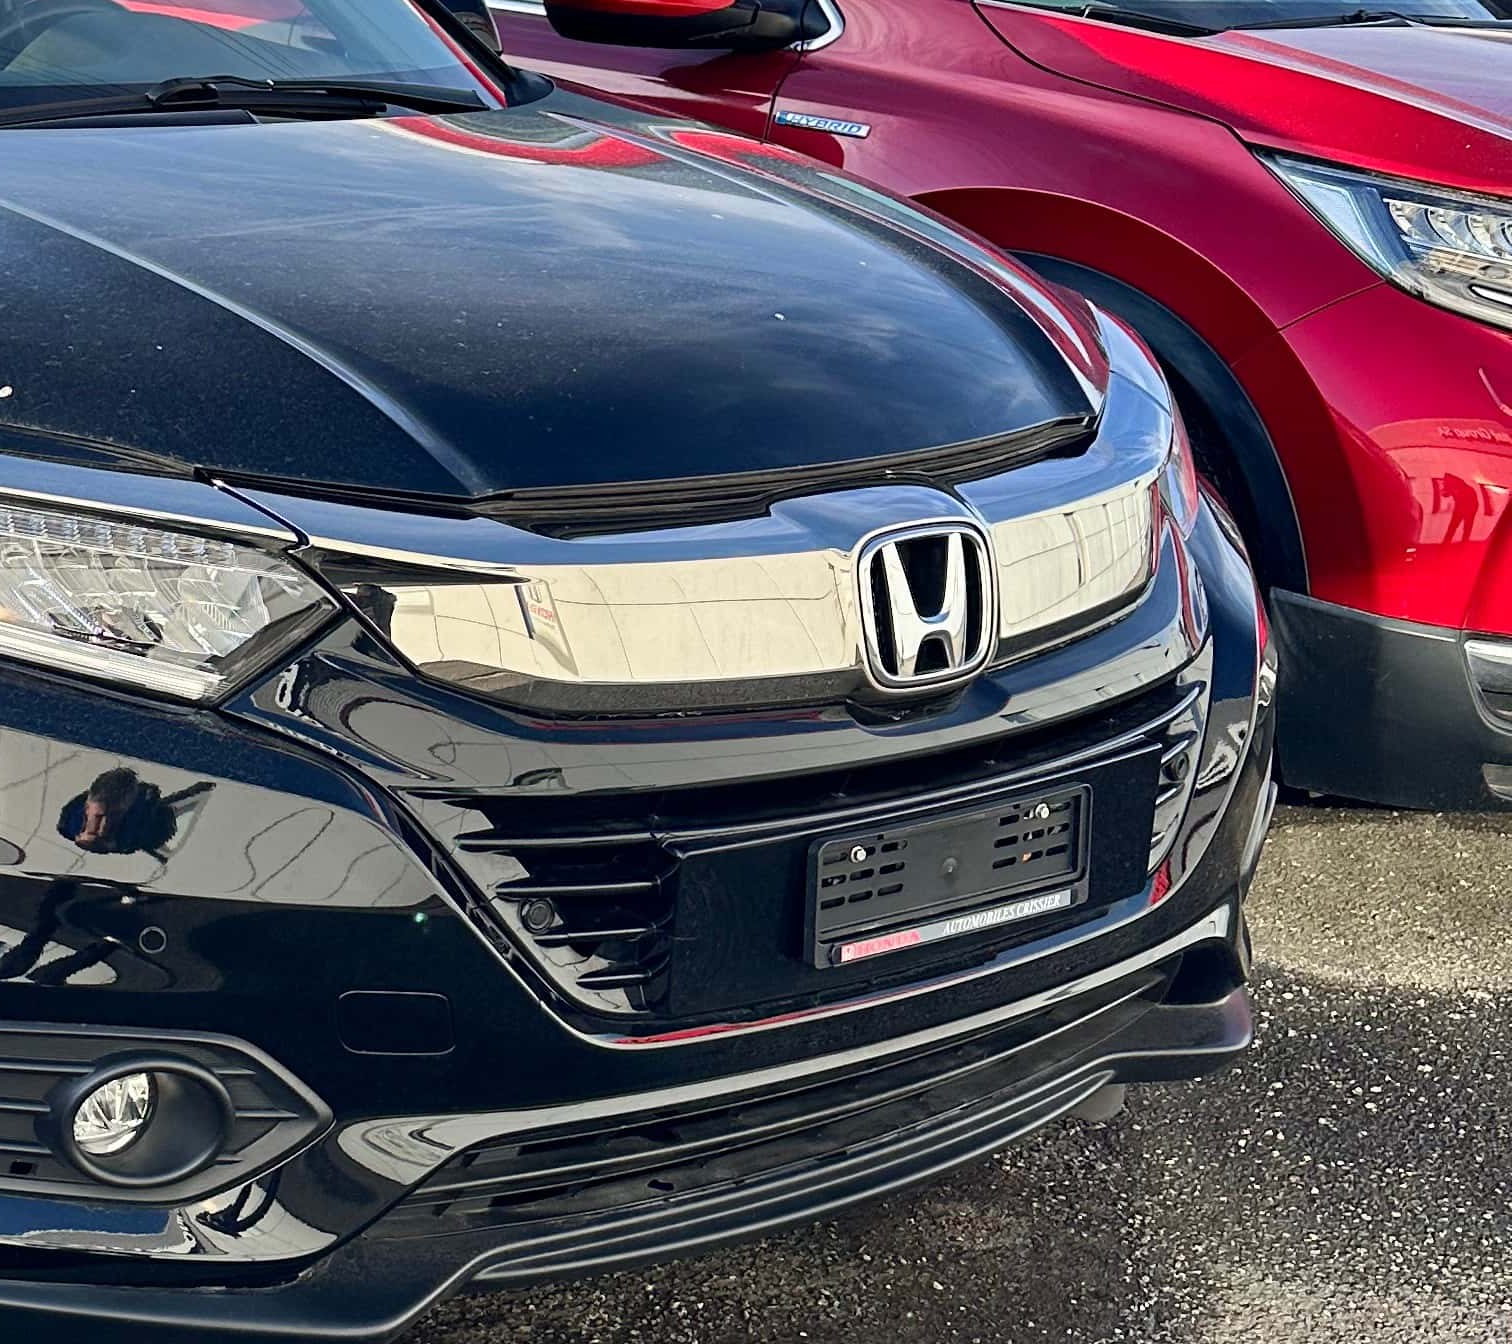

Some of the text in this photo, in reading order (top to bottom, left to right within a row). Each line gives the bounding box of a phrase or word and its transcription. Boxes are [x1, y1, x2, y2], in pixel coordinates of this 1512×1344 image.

[790, 115, 863, 134] HYBRID
[943, 902, 1016, 936] AUTOMOBILES
[1016, 893, 1062, 918] CRISSIER
